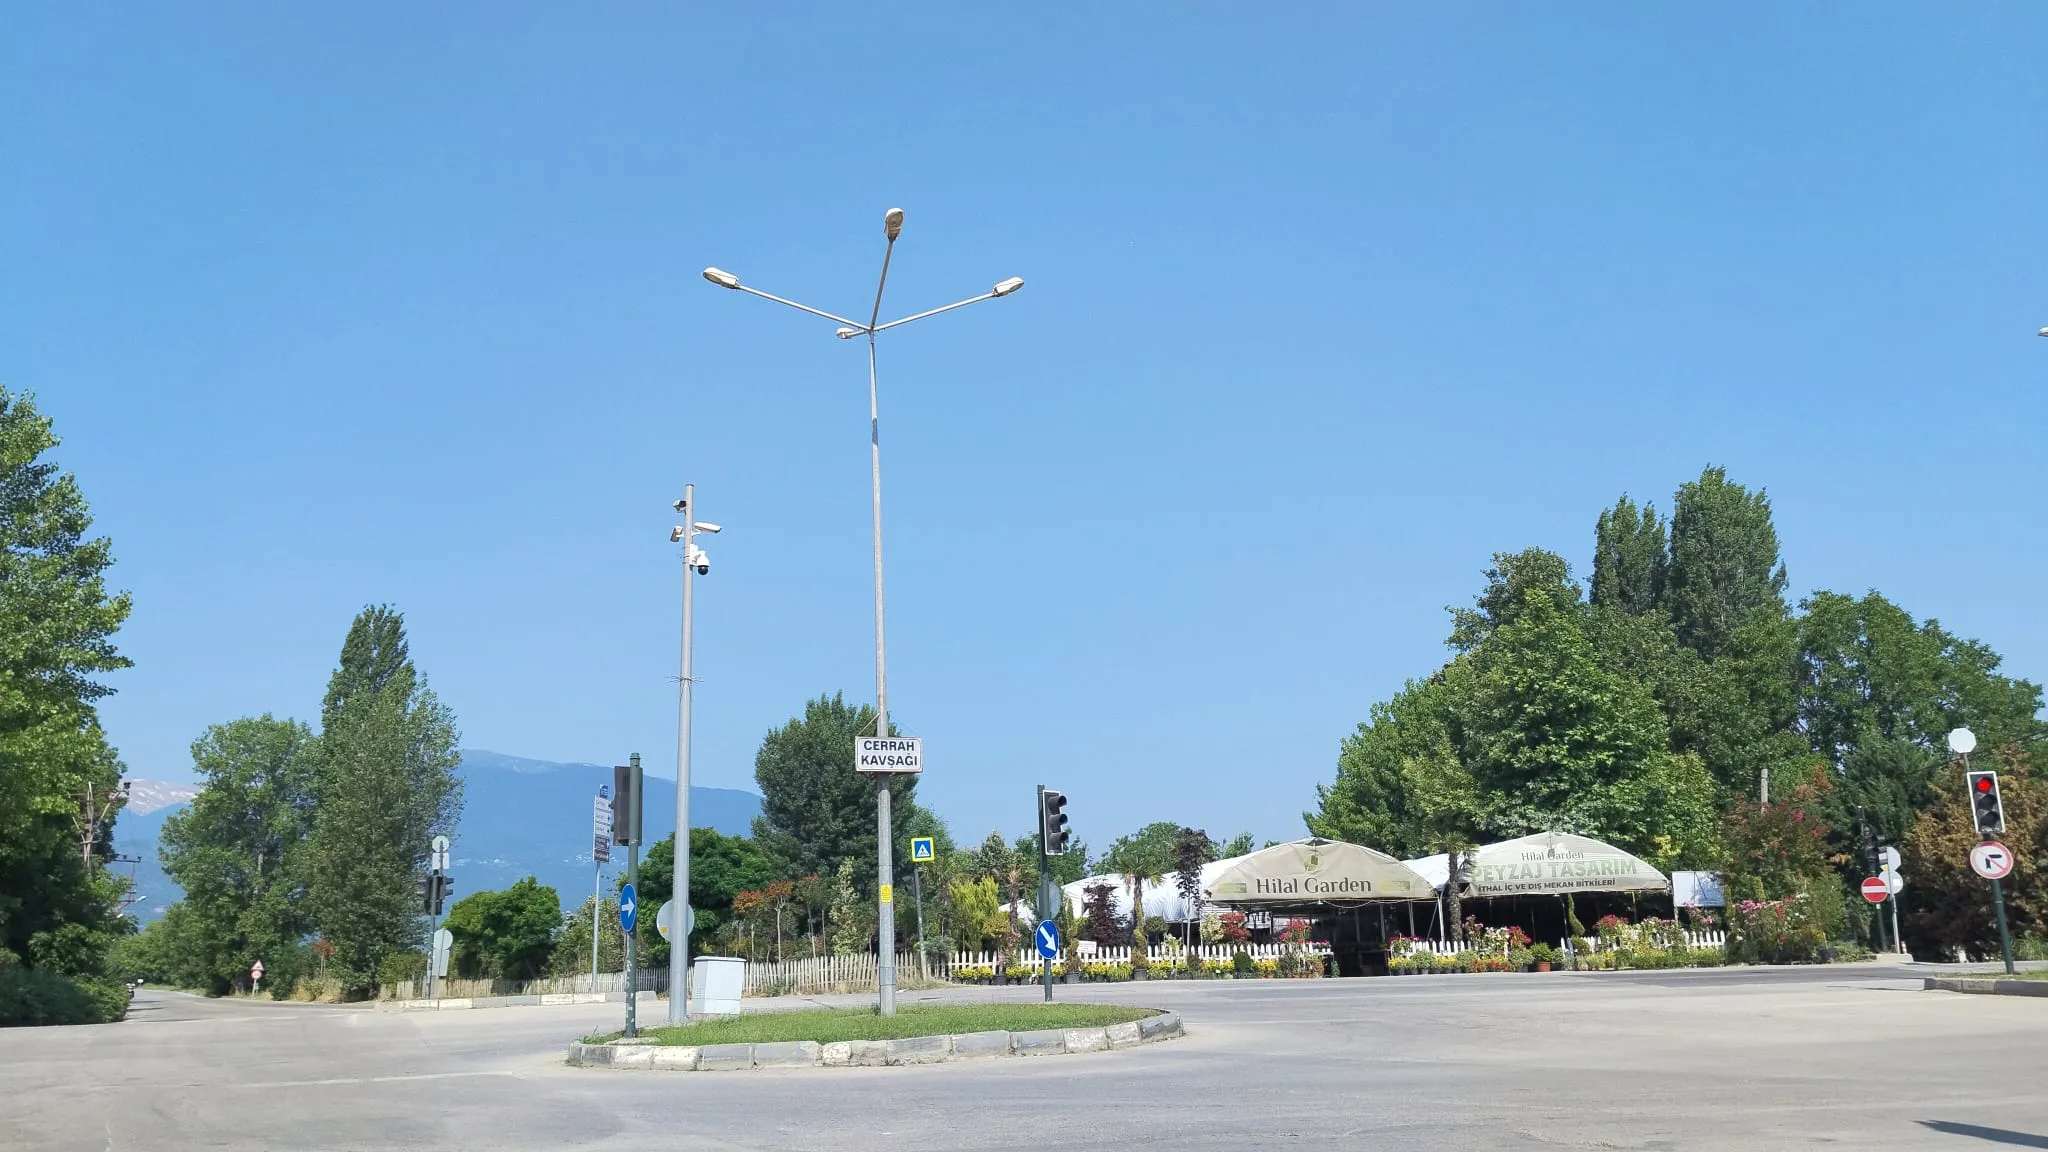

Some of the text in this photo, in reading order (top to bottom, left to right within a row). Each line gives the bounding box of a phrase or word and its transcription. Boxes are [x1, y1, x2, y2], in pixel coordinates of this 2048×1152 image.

[864, 740, 914, 751] CERRAH
[861, 753, 917, 768] KAVŞAĞI
[1521, 852, 1545, 861] Hilal
[1547, 859, 1637, 878] TASARIM
[1256, 878, 1298, 894] Hilal
[1304, 877, 1371, 894] Garden
[1544, 881, 1574, 889] MEKAN
[1576, 878, 1616, 888] BİTKİLERİ
